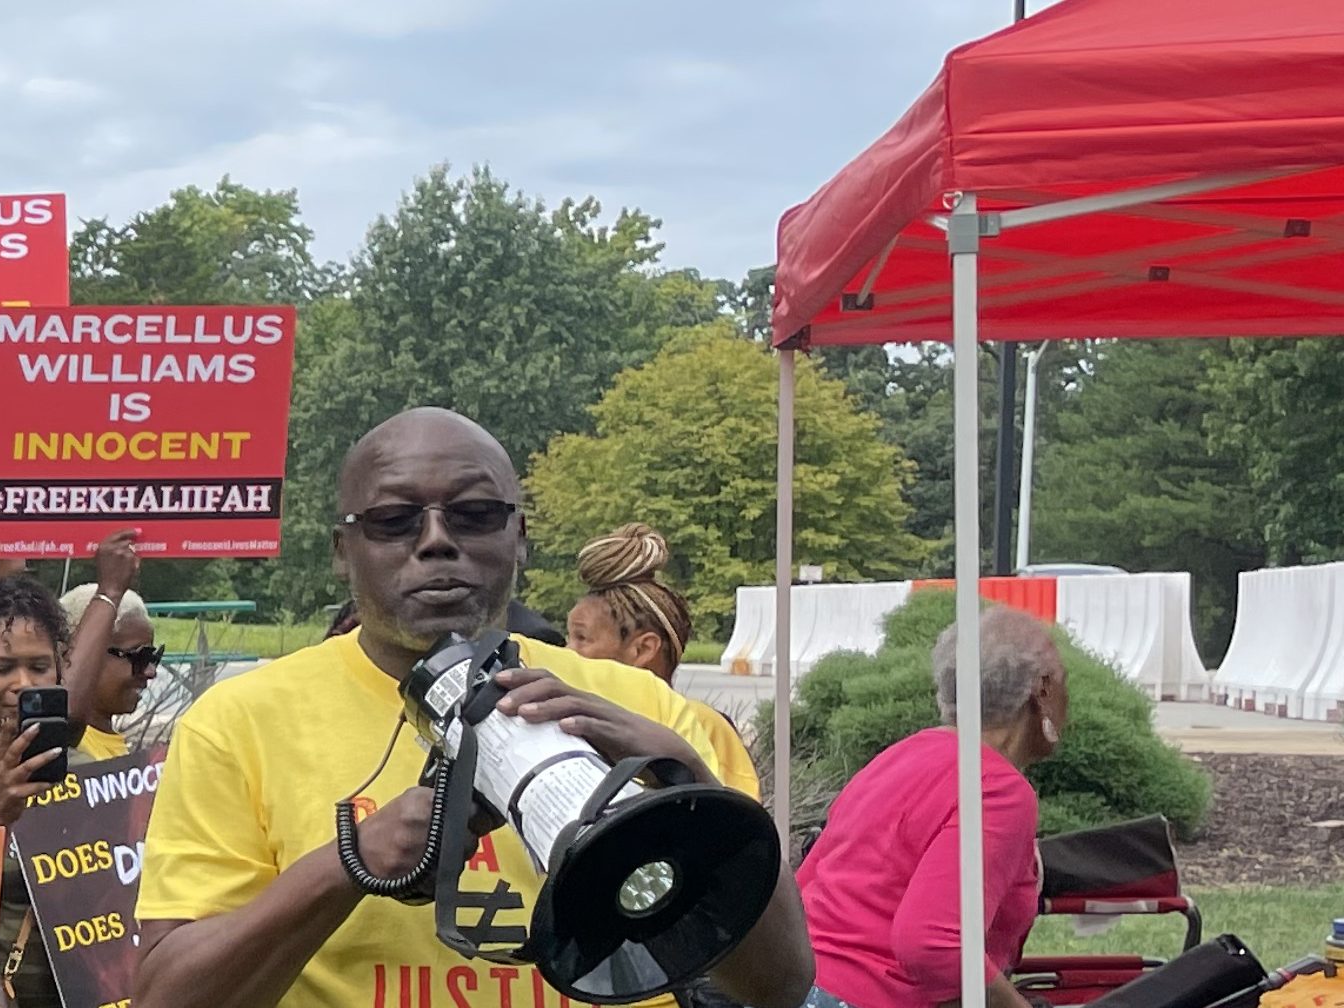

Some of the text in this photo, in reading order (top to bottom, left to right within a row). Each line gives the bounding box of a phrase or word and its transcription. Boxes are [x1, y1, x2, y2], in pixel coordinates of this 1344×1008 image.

[18, 354, 255, 383] WILLIAMS
[110, 394, 150, 422] IS
[13, 431, 251, 460] INNOCENT
[84, 764, 164, 808] INNOC
[31, 840, 113, 885] DOES
[54, 912, 124, 952] DOES
